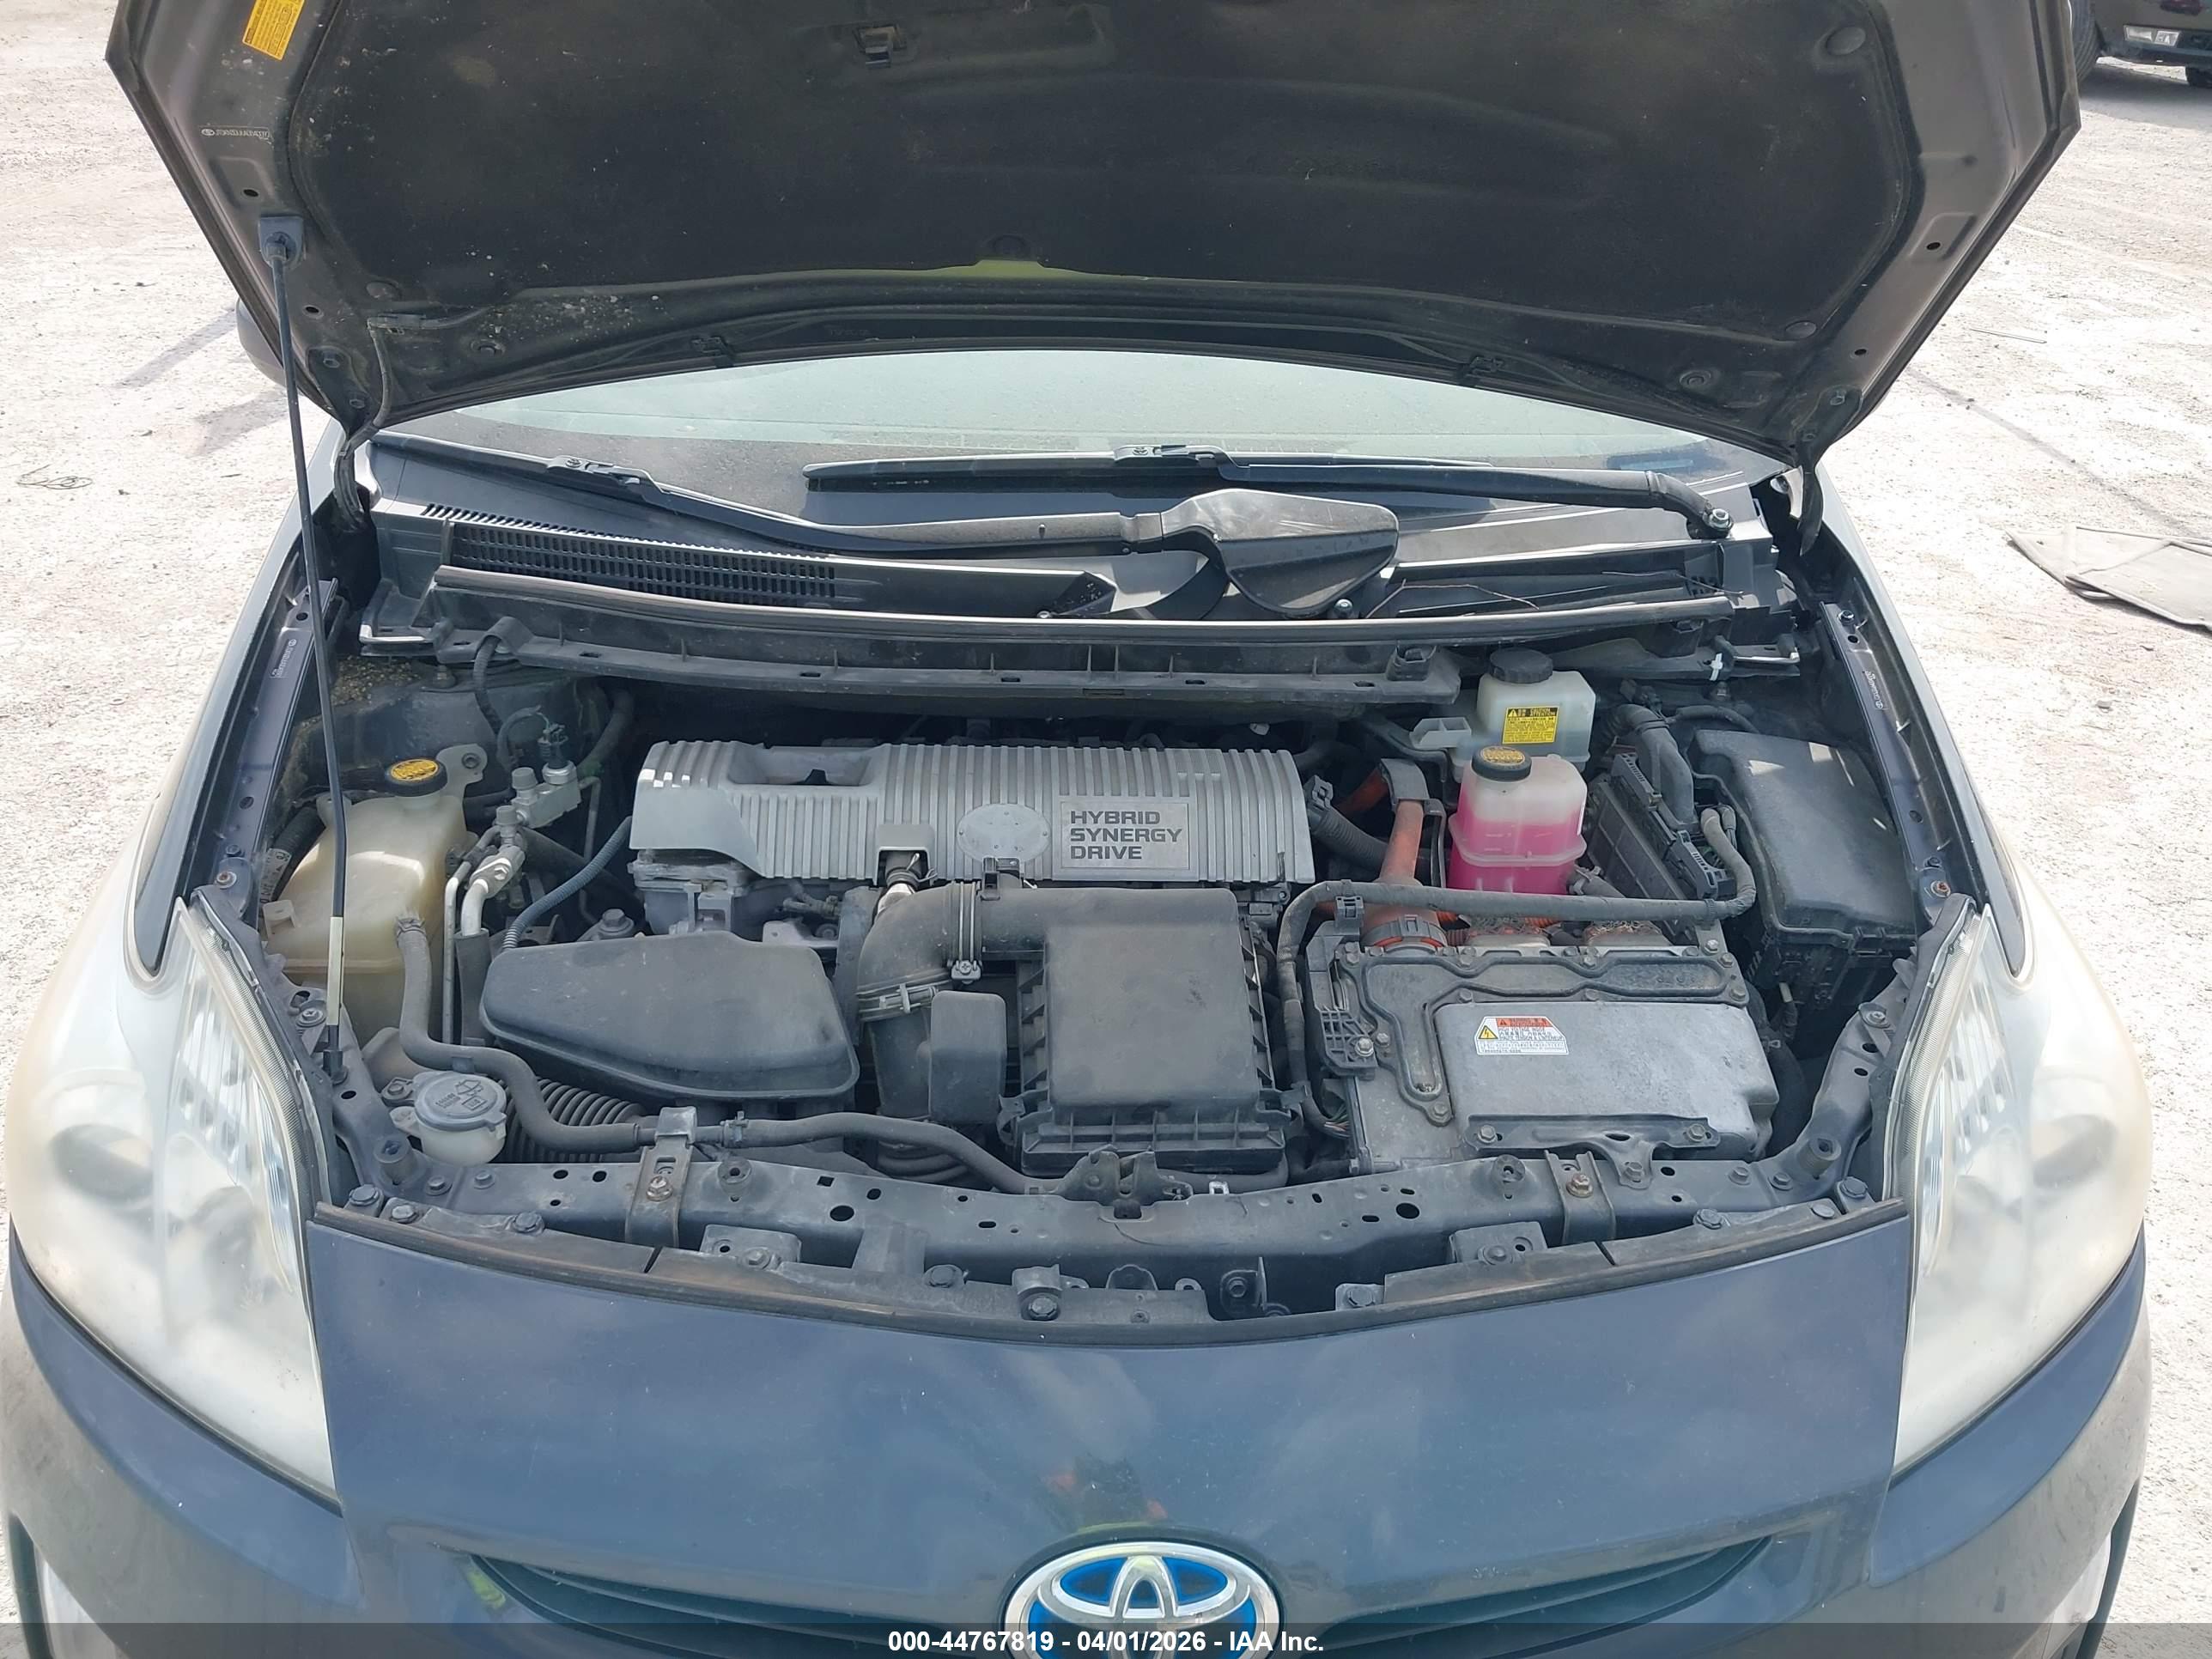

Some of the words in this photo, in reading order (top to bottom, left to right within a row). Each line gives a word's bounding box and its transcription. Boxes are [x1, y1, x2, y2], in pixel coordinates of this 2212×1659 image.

[1070, 811, 1161, 824] HYBRID
[1070, 828, 1182, 842] SYNERGY
[1070, 846, 1142, 860] DRIVE
